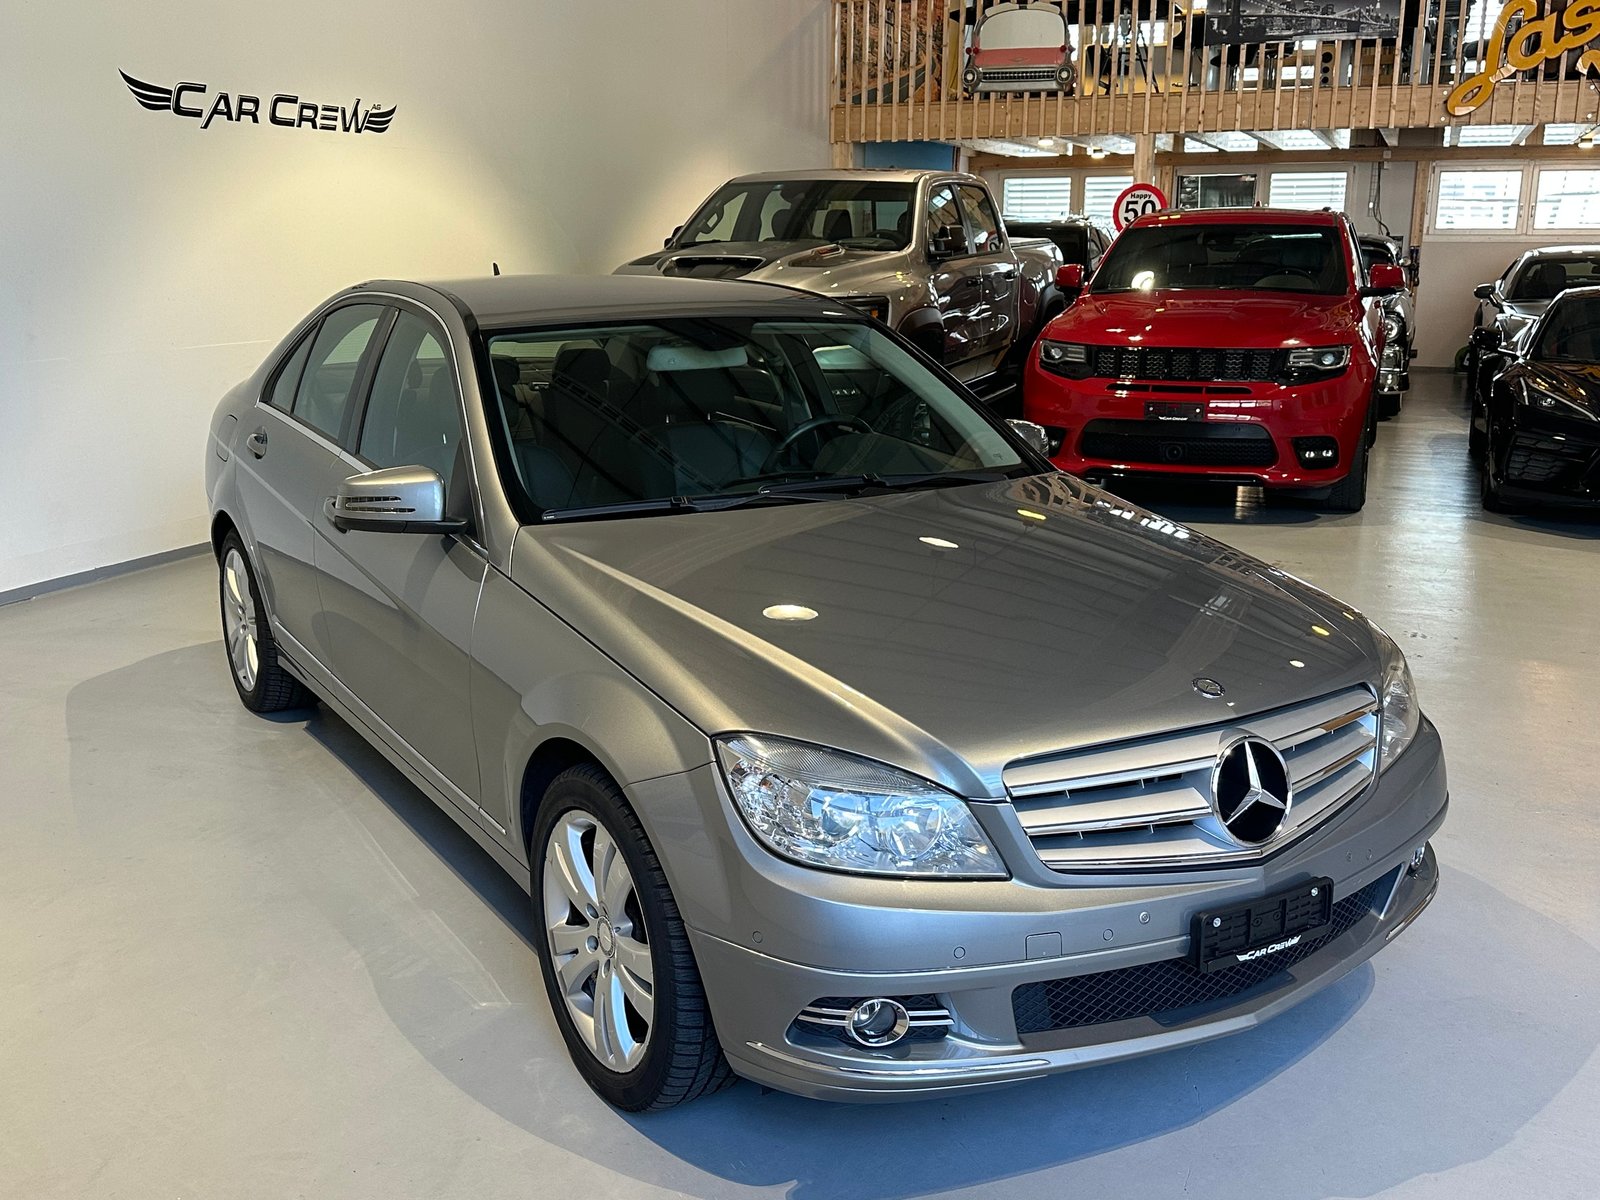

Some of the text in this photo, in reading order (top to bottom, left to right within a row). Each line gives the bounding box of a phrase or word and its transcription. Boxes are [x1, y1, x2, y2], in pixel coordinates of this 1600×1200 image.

[171, 81, 370, 134] CAR CREW
[1124, 200, 1156, 223] 50
